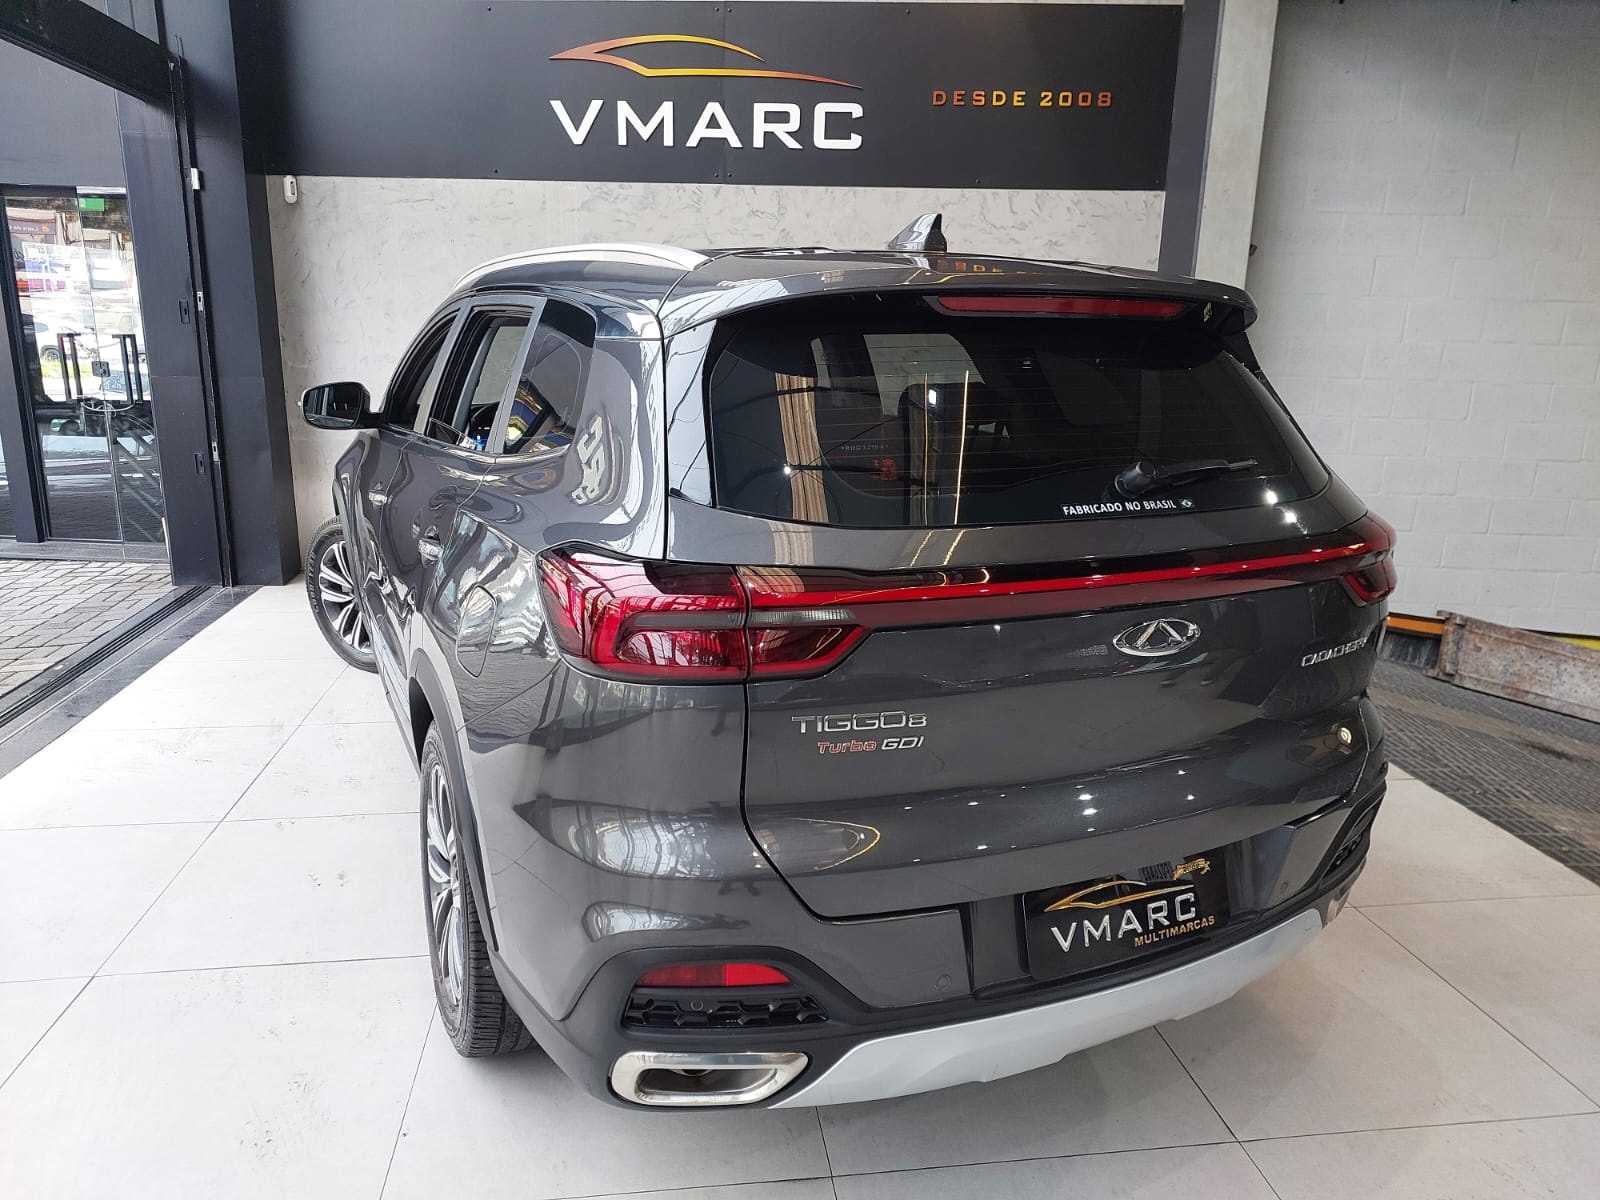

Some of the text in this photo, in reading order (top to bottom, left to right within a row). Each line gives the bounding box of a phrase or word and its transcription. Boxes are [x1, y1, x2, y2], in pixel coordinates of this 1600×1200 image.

[932, 90, 1112, 107] DESDE 2008
[549, 99, 864, 150] VMARC
[1062, 499, 1177, 516] FABRICADO NO BRASIL
[817, 736, 925, 754] Turbo GDI
[1050, 892, 1196, 953] VMARC
[1134, 915, 1216, 948] MULTIMARCAS
